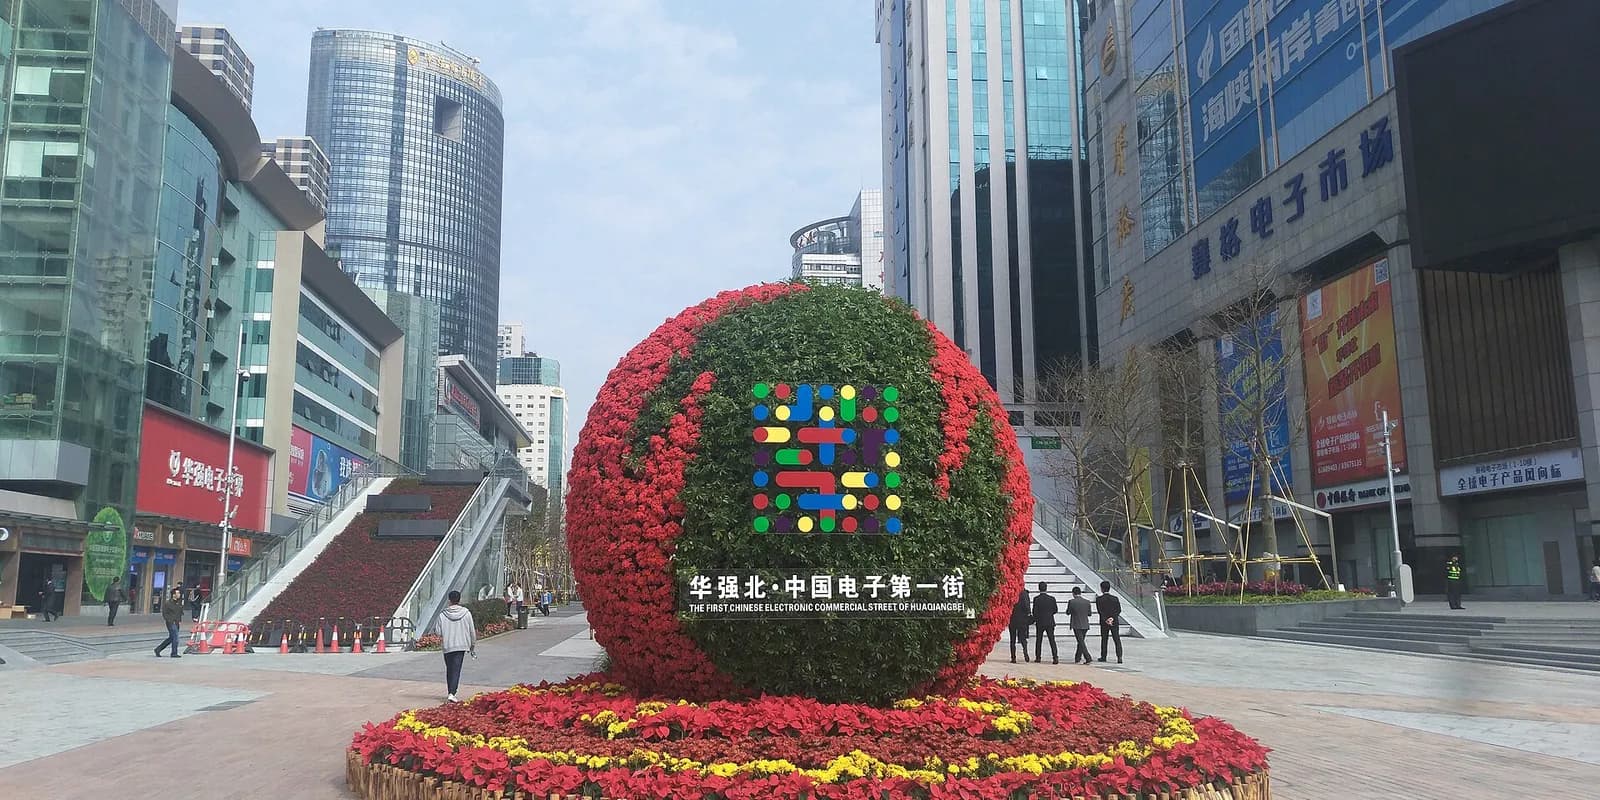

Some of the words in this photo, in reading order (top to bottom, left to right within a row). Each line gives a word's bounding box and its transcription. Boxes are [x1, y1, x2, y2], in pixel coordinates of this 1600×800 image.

[1458, 463, 1562, 491] 全球电子产品风向标
[689, 574, 965, 600] 华强北·中国电子第一街
[689, 603, 704, 612] THE
[707, 603, 728, 612] FIRST
[730, 603, 764, 612] CHINESE
[765, 603, 814, 612] ELECTRONIC
[814, 603, 867, 612] COMMERCIAL
[868, 603, 897, 612] STREET
[899, 603, 909, 612] OF
[911, 603, 965, 612] HUAQIANGBEI
